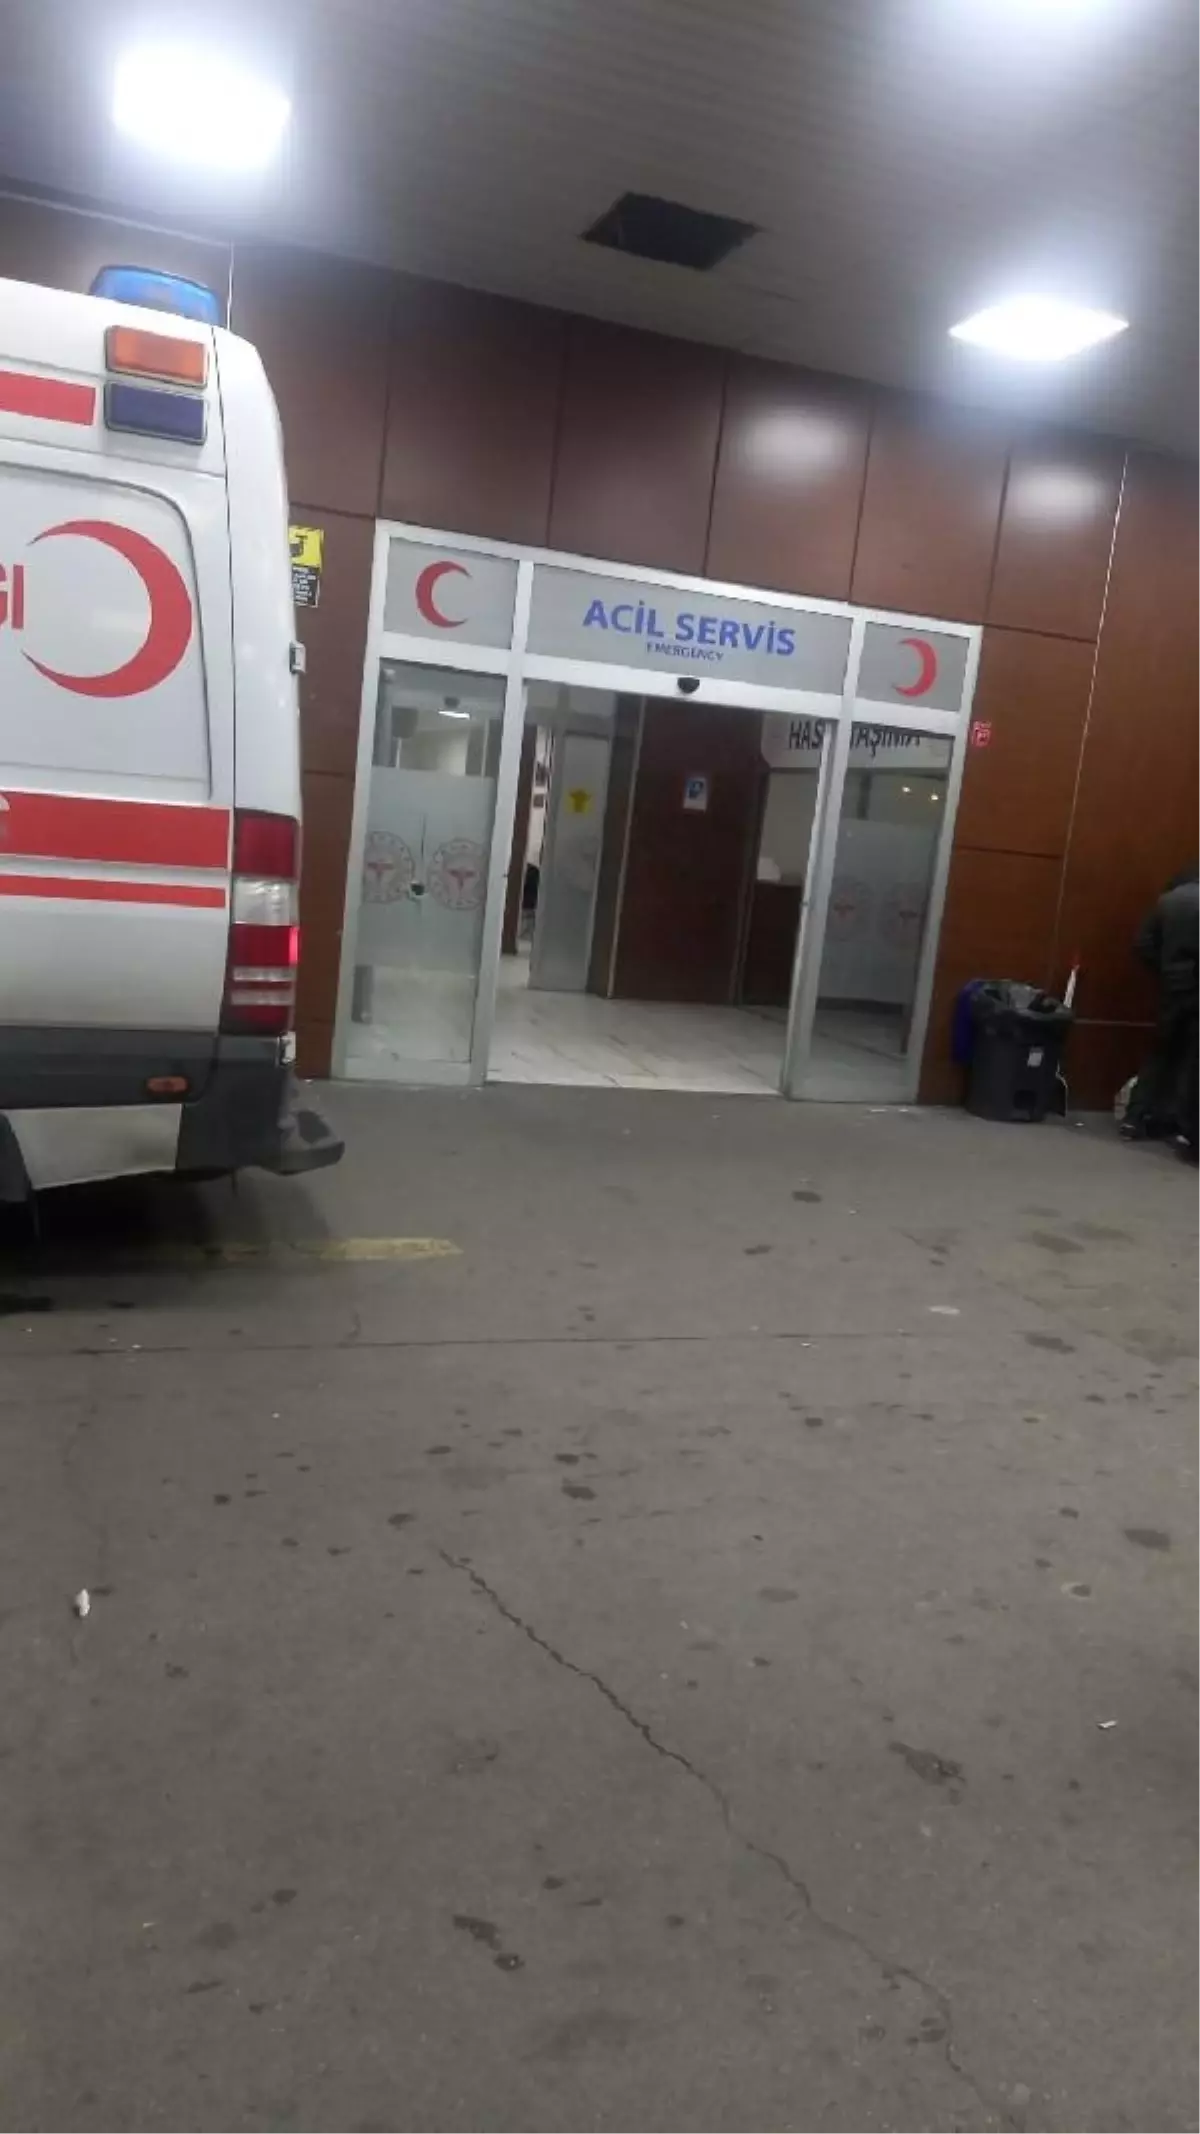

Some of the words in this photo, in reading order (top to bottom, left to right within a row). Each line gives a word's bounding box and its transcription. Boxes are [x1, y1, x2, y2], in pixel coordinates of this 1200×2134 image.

[582, 599, 665, 638] ACİL
[675, 613, 796, 656] SERVİS
[646, 642, 724, 662] EMERGENCY
